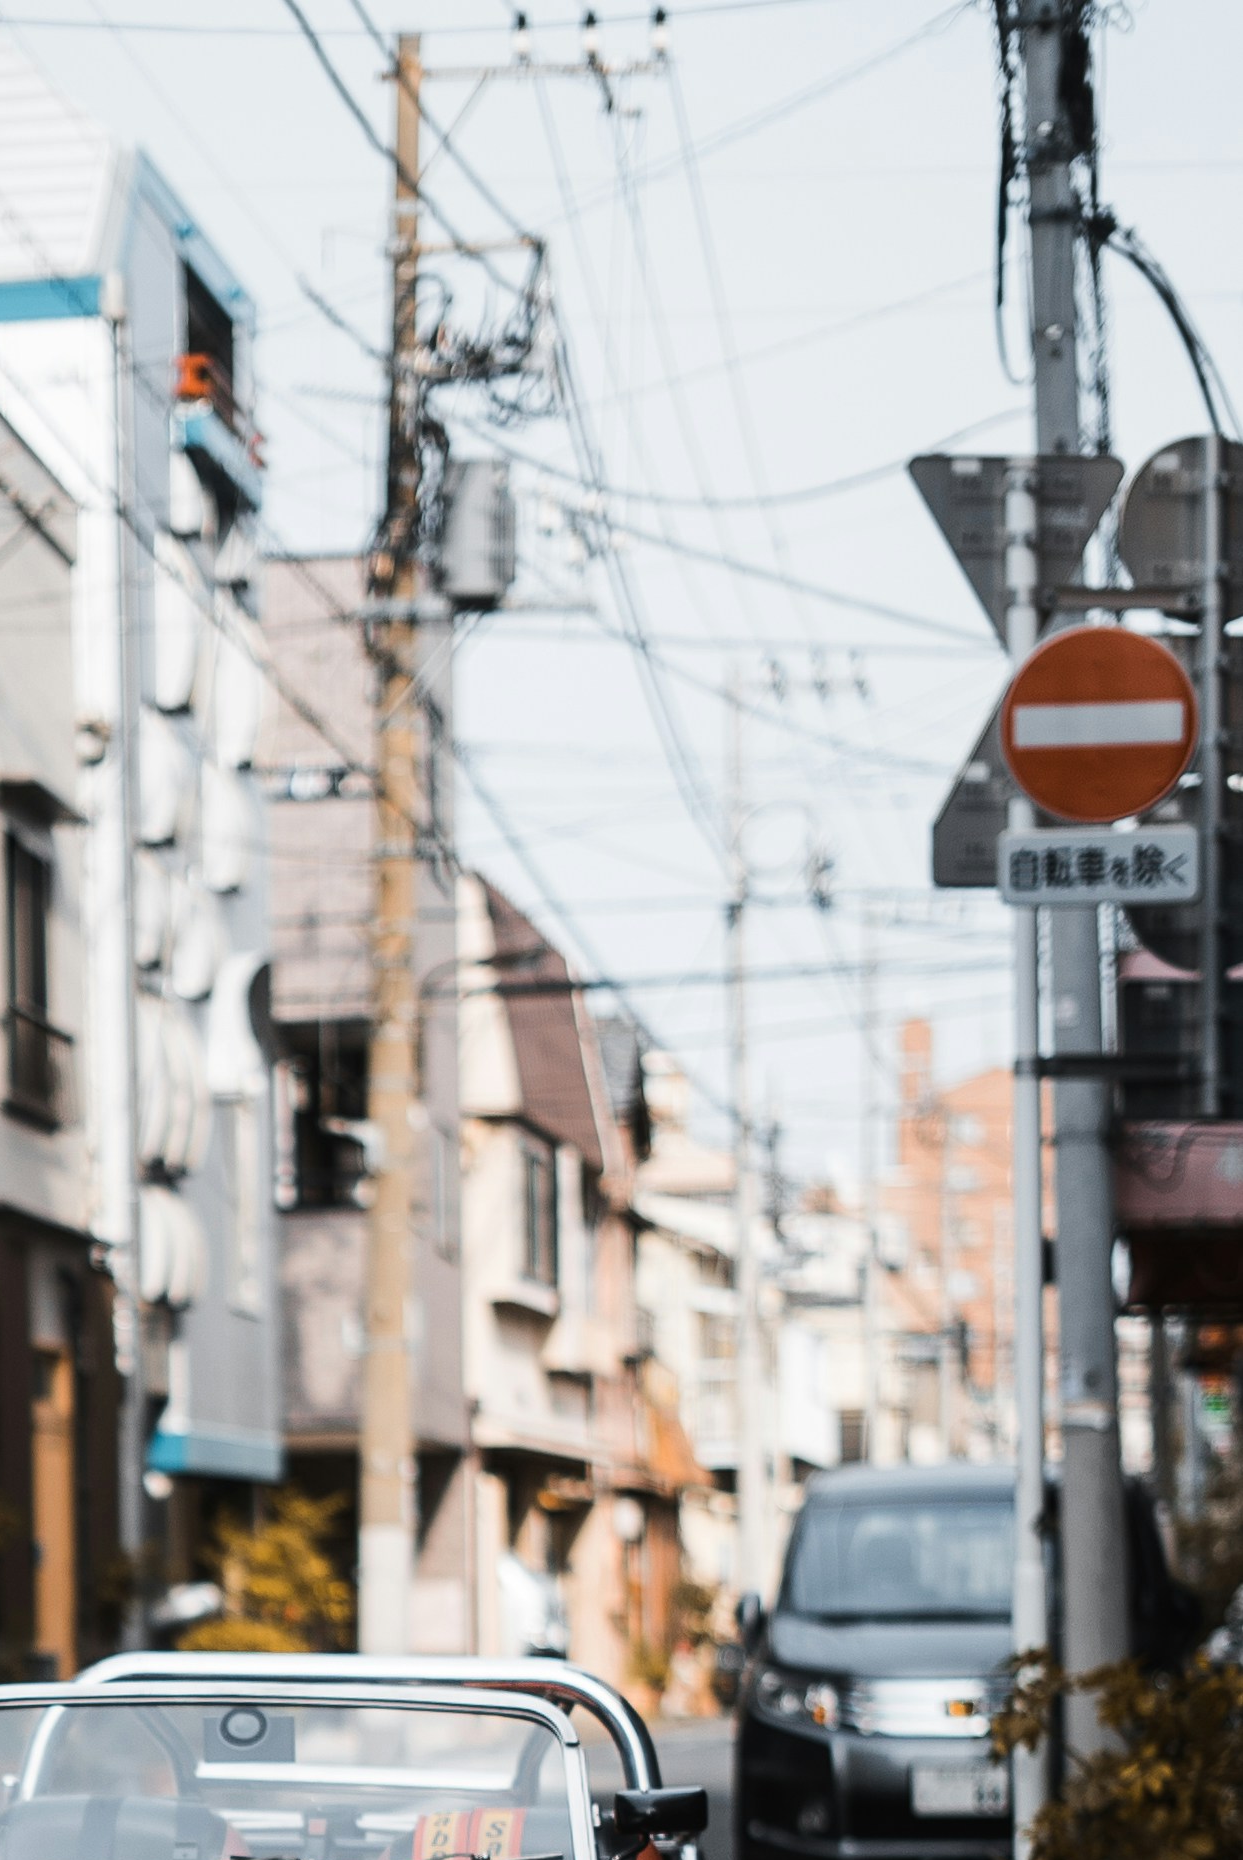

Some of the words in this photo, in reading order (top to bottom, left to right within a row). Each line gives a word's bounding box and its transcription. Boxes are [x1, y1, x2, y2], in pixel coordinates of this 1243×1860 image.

[1009, 844, 1189, 892] 自転車を除く
